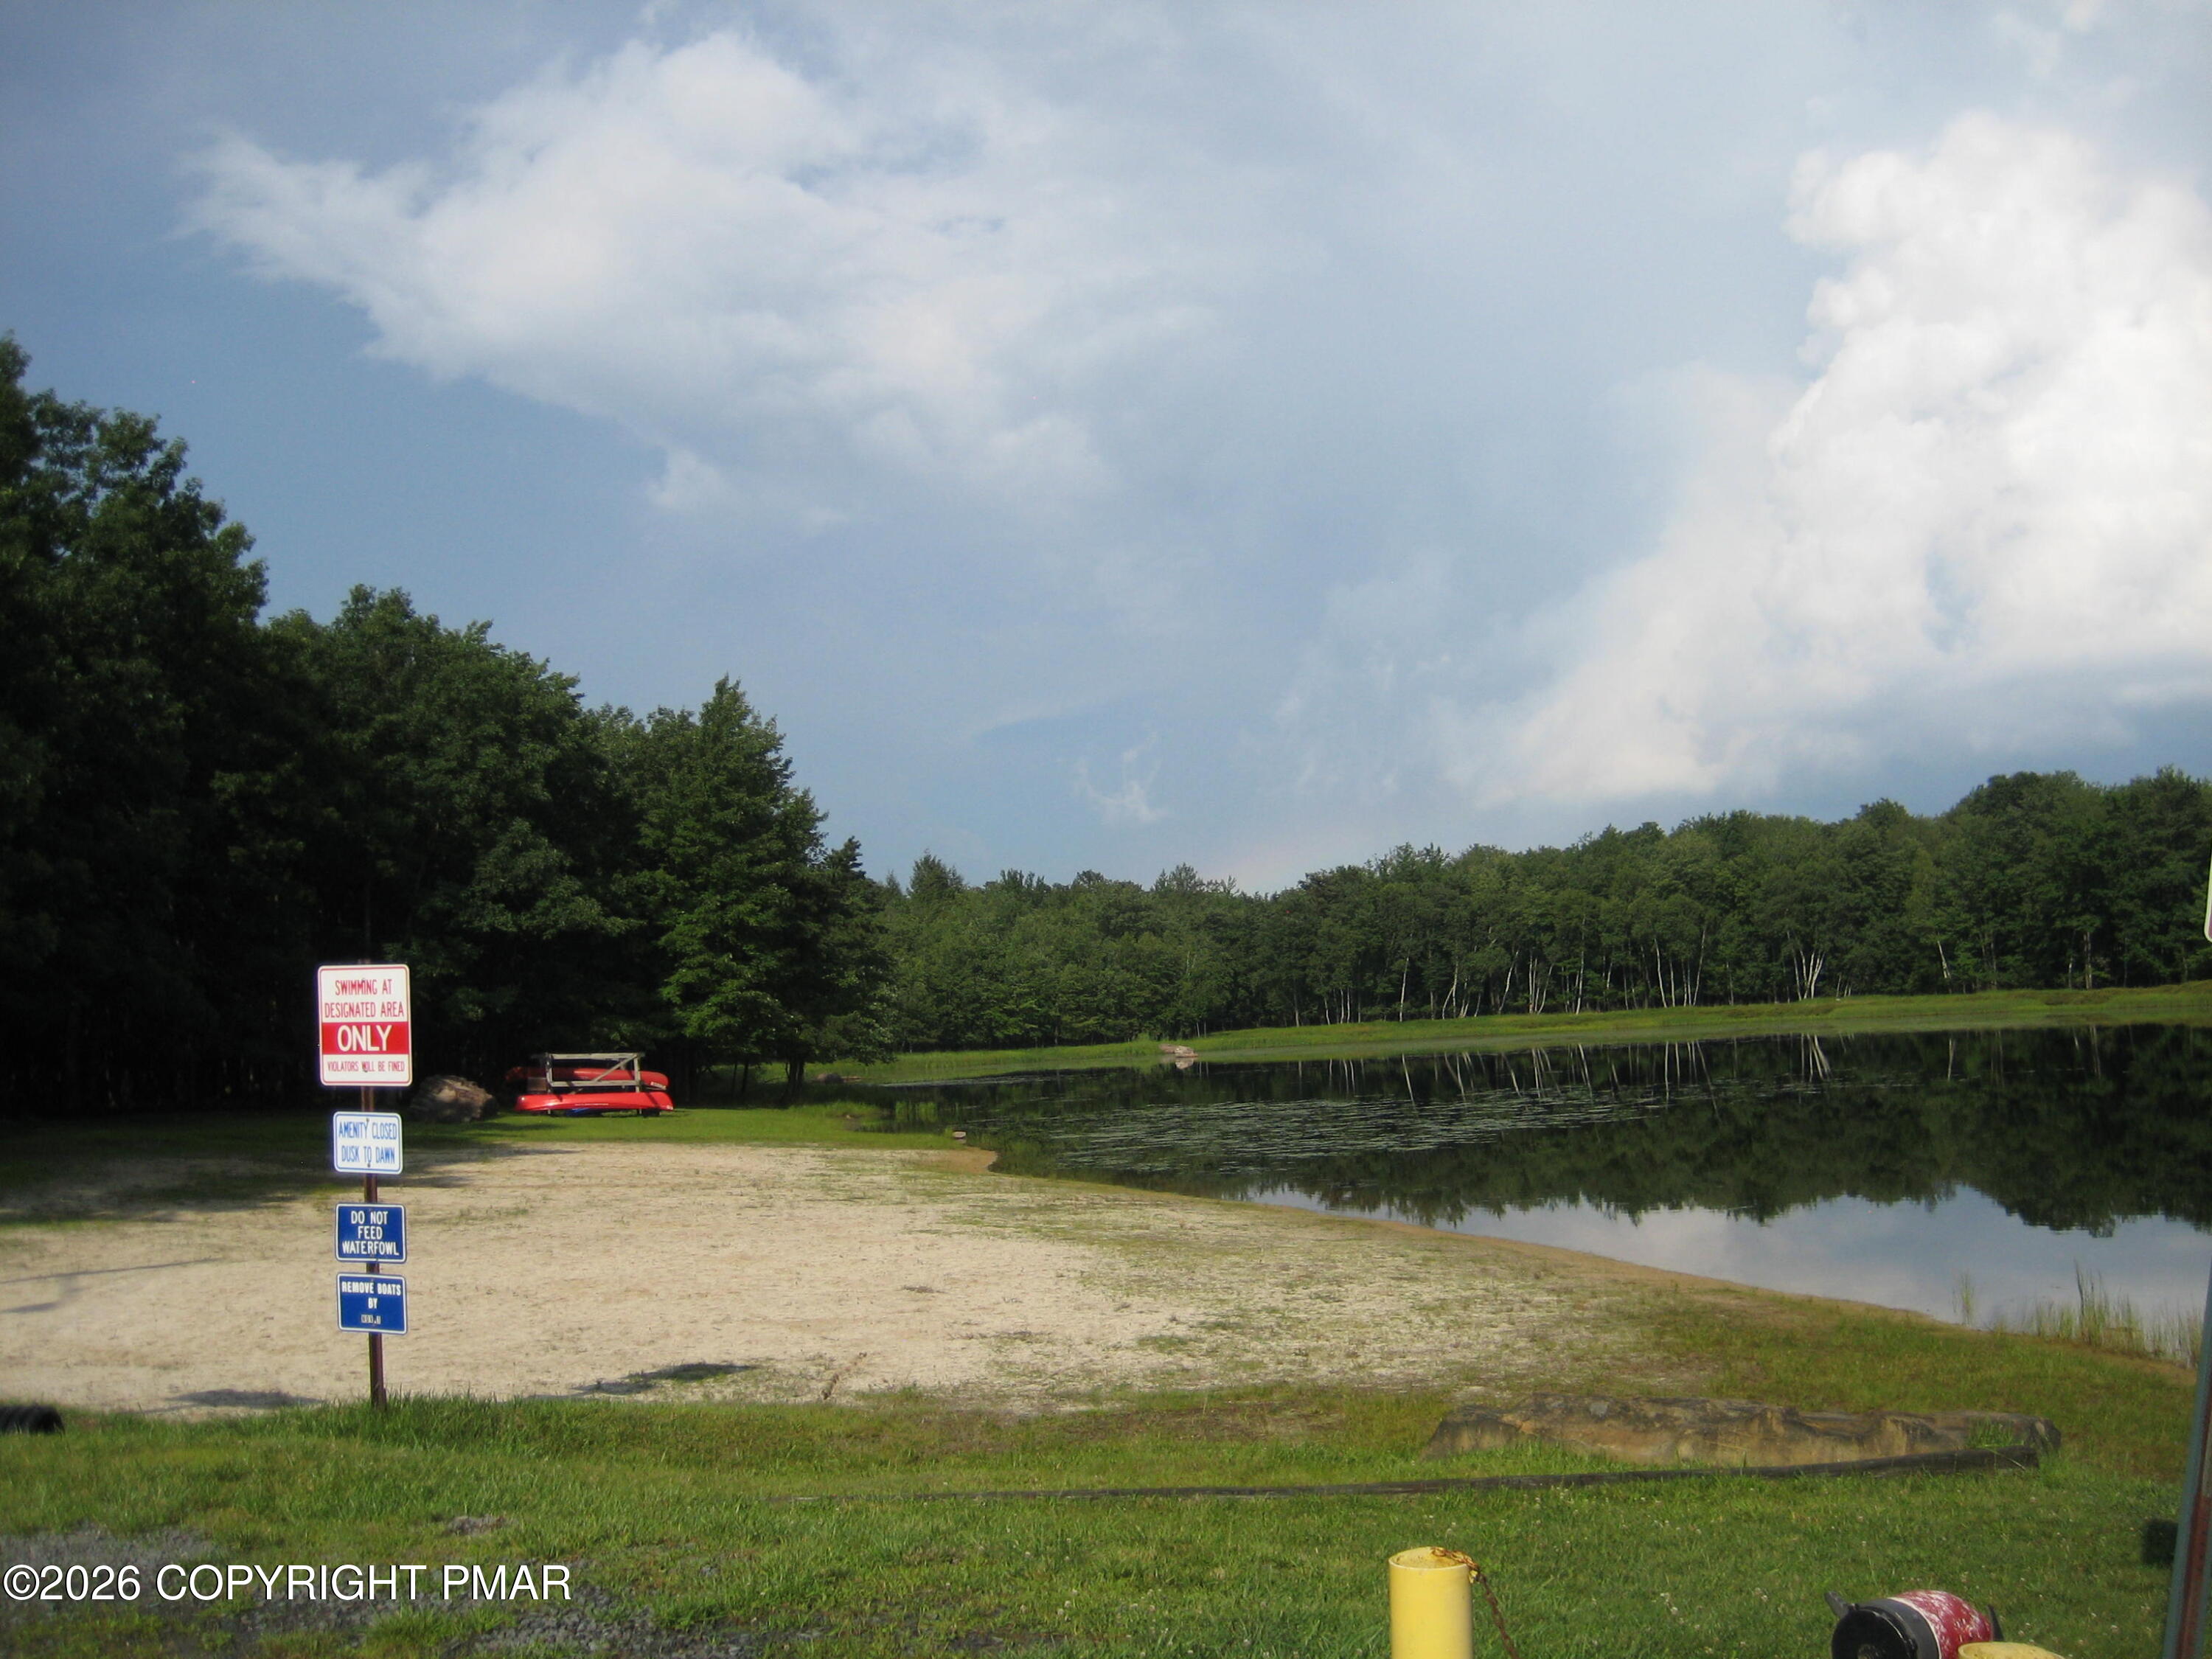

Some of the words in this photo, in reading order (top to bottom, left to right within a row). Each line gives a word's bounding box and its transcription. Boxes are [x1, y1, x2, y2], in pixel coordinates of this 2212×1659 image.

[335, 979, 378, 995] SWIMMING
[382, 978, 392, 995] AT
[324, 1002, 376, 1018] DESIGNATED
[380, 1001, 404, 1018] AREA
[337, 1024, 392, 1052] ONLY
[327, 1061, 359, 1072] VIOLATORS
[361, 1061, 375, 1072] WILL
[378, 1061, 385, 1072] BE
[388, 1061, 405, 1071] FINED
[338, 1121, 368, 1138] AMENITY
[372, 1122, 397, 1140] CLOSED
[341, 1145, 359, 1162] DUSK
[364, 1146, 372, 1163] TO
[375, 1147, 395, 1164] DAWN
[351, 1211, 365, 1224] DO
[370, 1211, 388, 1225] NOT
[358, 1226, 383, 1239] FEED
[342, 1241, 400, 1256] WATERFOWL
[341, 1281, 374, 1294] REMOVE
[377, 1283, 401, 1295] BOATS
[368, 1297, 378, 1309] BY
